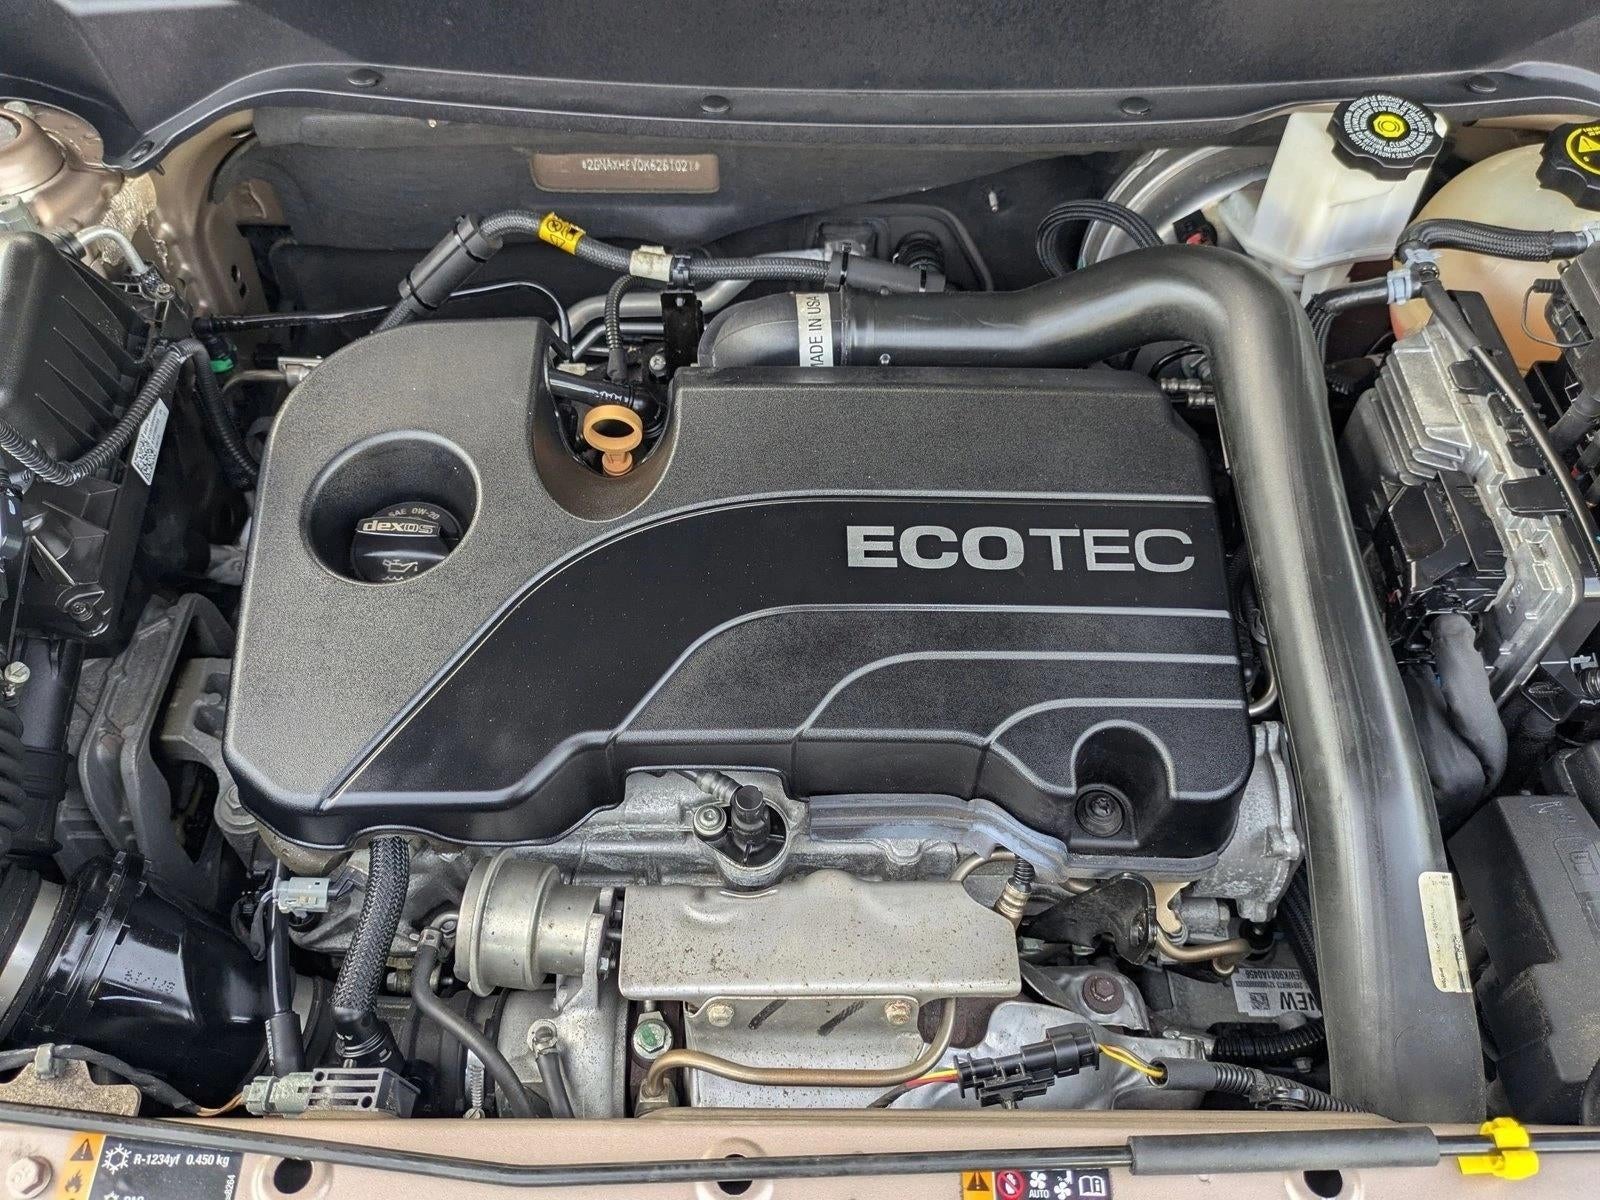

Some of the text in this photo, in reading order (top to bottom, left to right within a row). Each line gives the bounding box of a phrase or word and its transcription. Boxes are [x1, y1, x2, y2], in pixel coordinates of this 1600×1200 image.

[806, 296, 824, 367] ADE IN USA
[362, 520, 436, 534] dexos
[846, 525, 1195, 573] ECOTEC
[133, 1153, 230, 1168] R-1234yf 0.450 kg
[1028, 1189, 1050, 1199] AUTO
